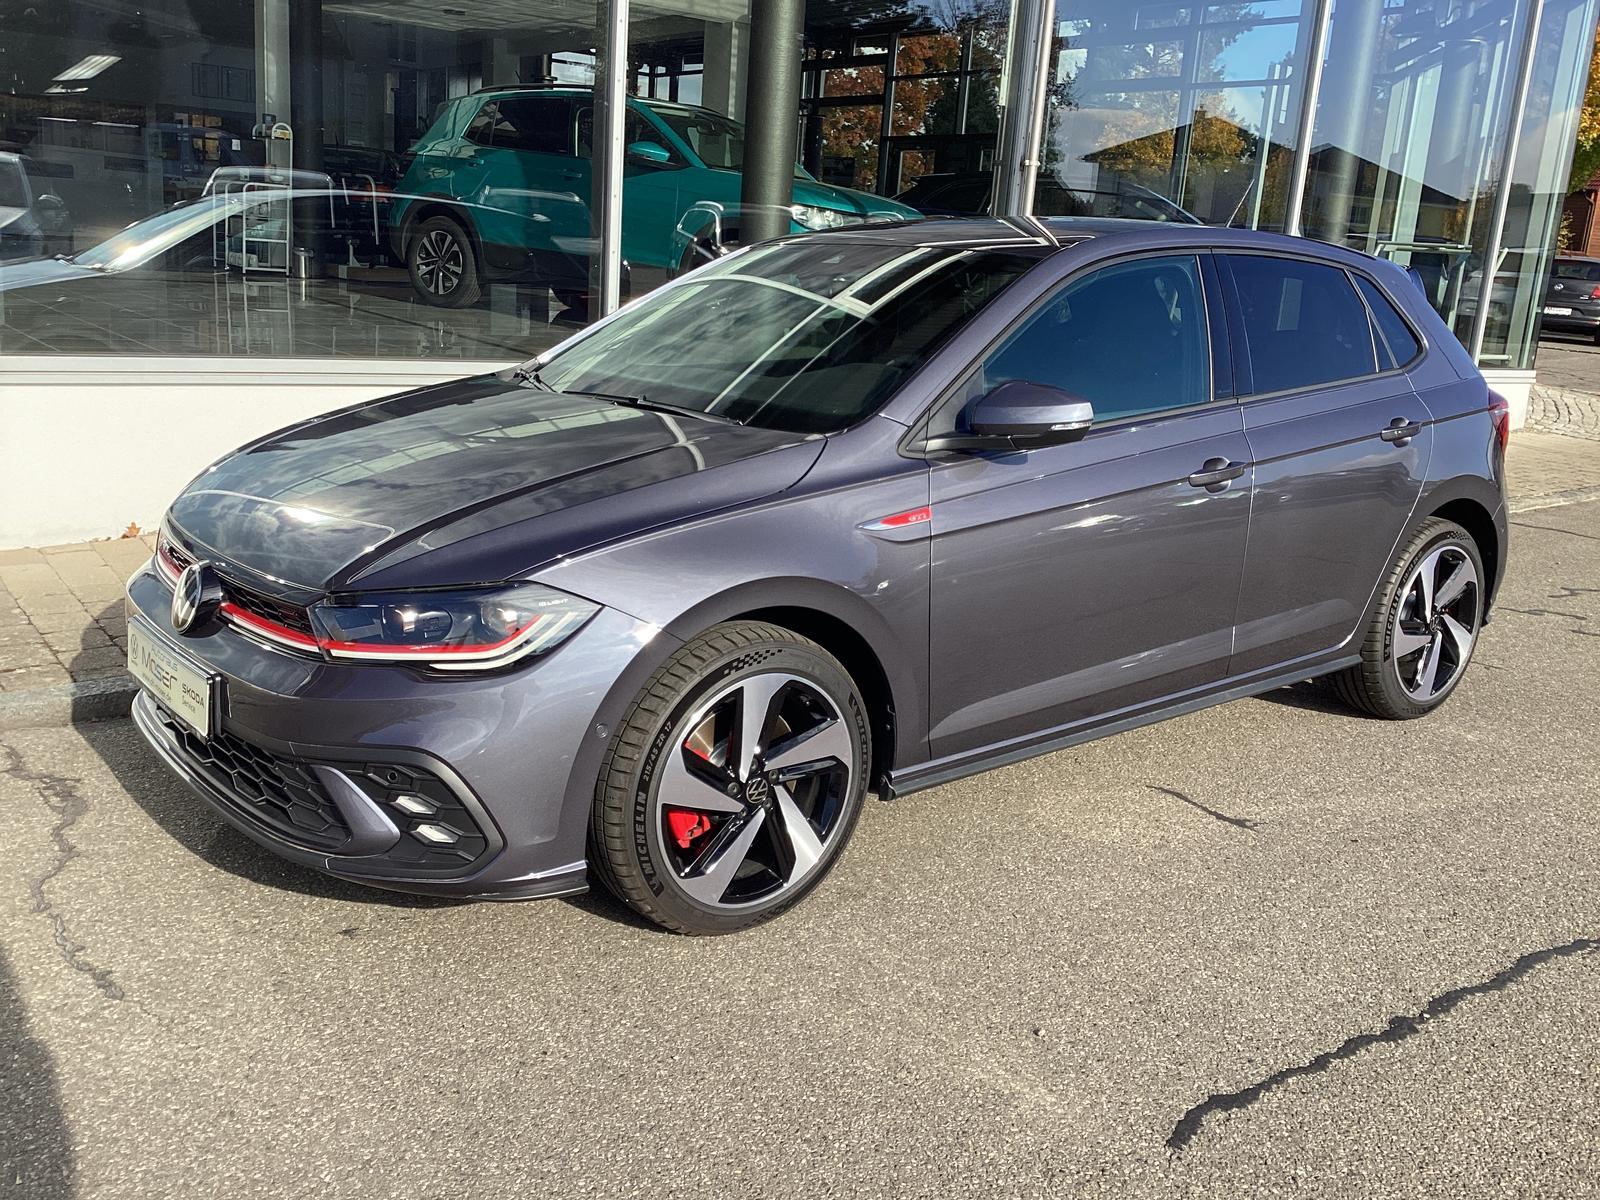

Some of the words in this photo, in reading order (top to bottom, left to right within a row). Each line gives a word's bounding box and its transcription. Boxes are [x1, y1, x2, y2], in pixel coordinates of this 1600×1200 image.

[656, 733, 666, 748] ZR
[664, 721, 672, 732] 17
[636, 791, 654, 875] MICHELIN
